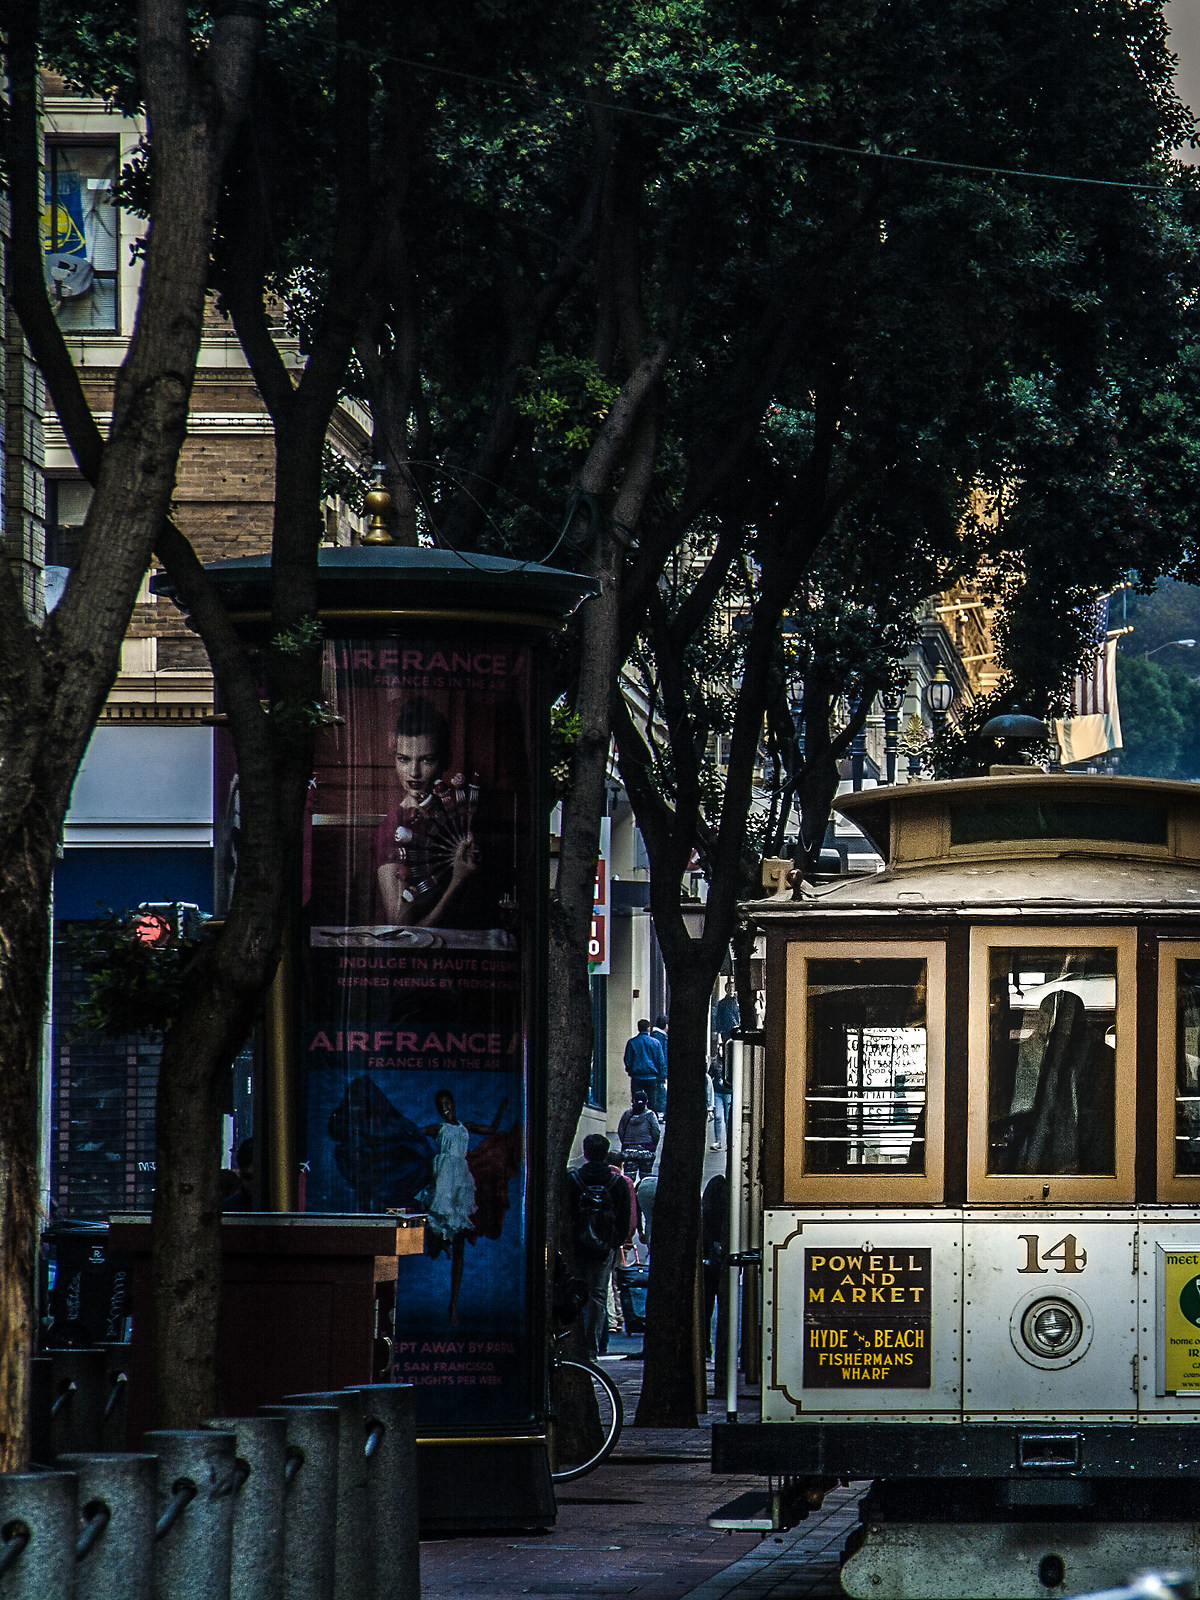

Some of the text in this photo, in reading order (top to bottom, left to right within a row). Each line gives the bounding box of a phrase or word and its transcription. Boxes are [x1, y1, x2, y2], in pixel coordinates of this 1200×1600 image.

[374, 675, 428, 686] FRANCE
[434, 676, 443, 687] IS
[449, 676, 463, 687] IN
[339, 957, 408, 969] INDULGE
[412, 957, 428, 969] IN
[432, 957, 477, 971] HAUTE
[337, 977, 390, 987] REFINED
[393, 977, 436, 988] MENUS
[308, 1030, 502, 1054] AIRFRANCE
[368, 1057, 423, 1068] FRANCE
[428, 1057, 438, 1068] IS
[443, 1057, 456, 1068] IN
[460, 1058, 481, 1069] THE
[1017, 1233, 1087, 1273] 14
[811, 1255, 923, 1271] POWELL
[840, 1273, 896, 1286] AND
[809, 1287, 925, 1303] MARKET
[810, 1329, 924, 1348] HYDE AND BEACH
[420, 1342, 464, 1353] AWAY
[469, 1342, 484, 1353] BY
[819, 1353, 914, 1366] FISHERMANS
[403, 1362, 430, 1372] SAN
[841, 1367, 890, 1380] WHARF
[457, 1375, 476, 1385] PER
